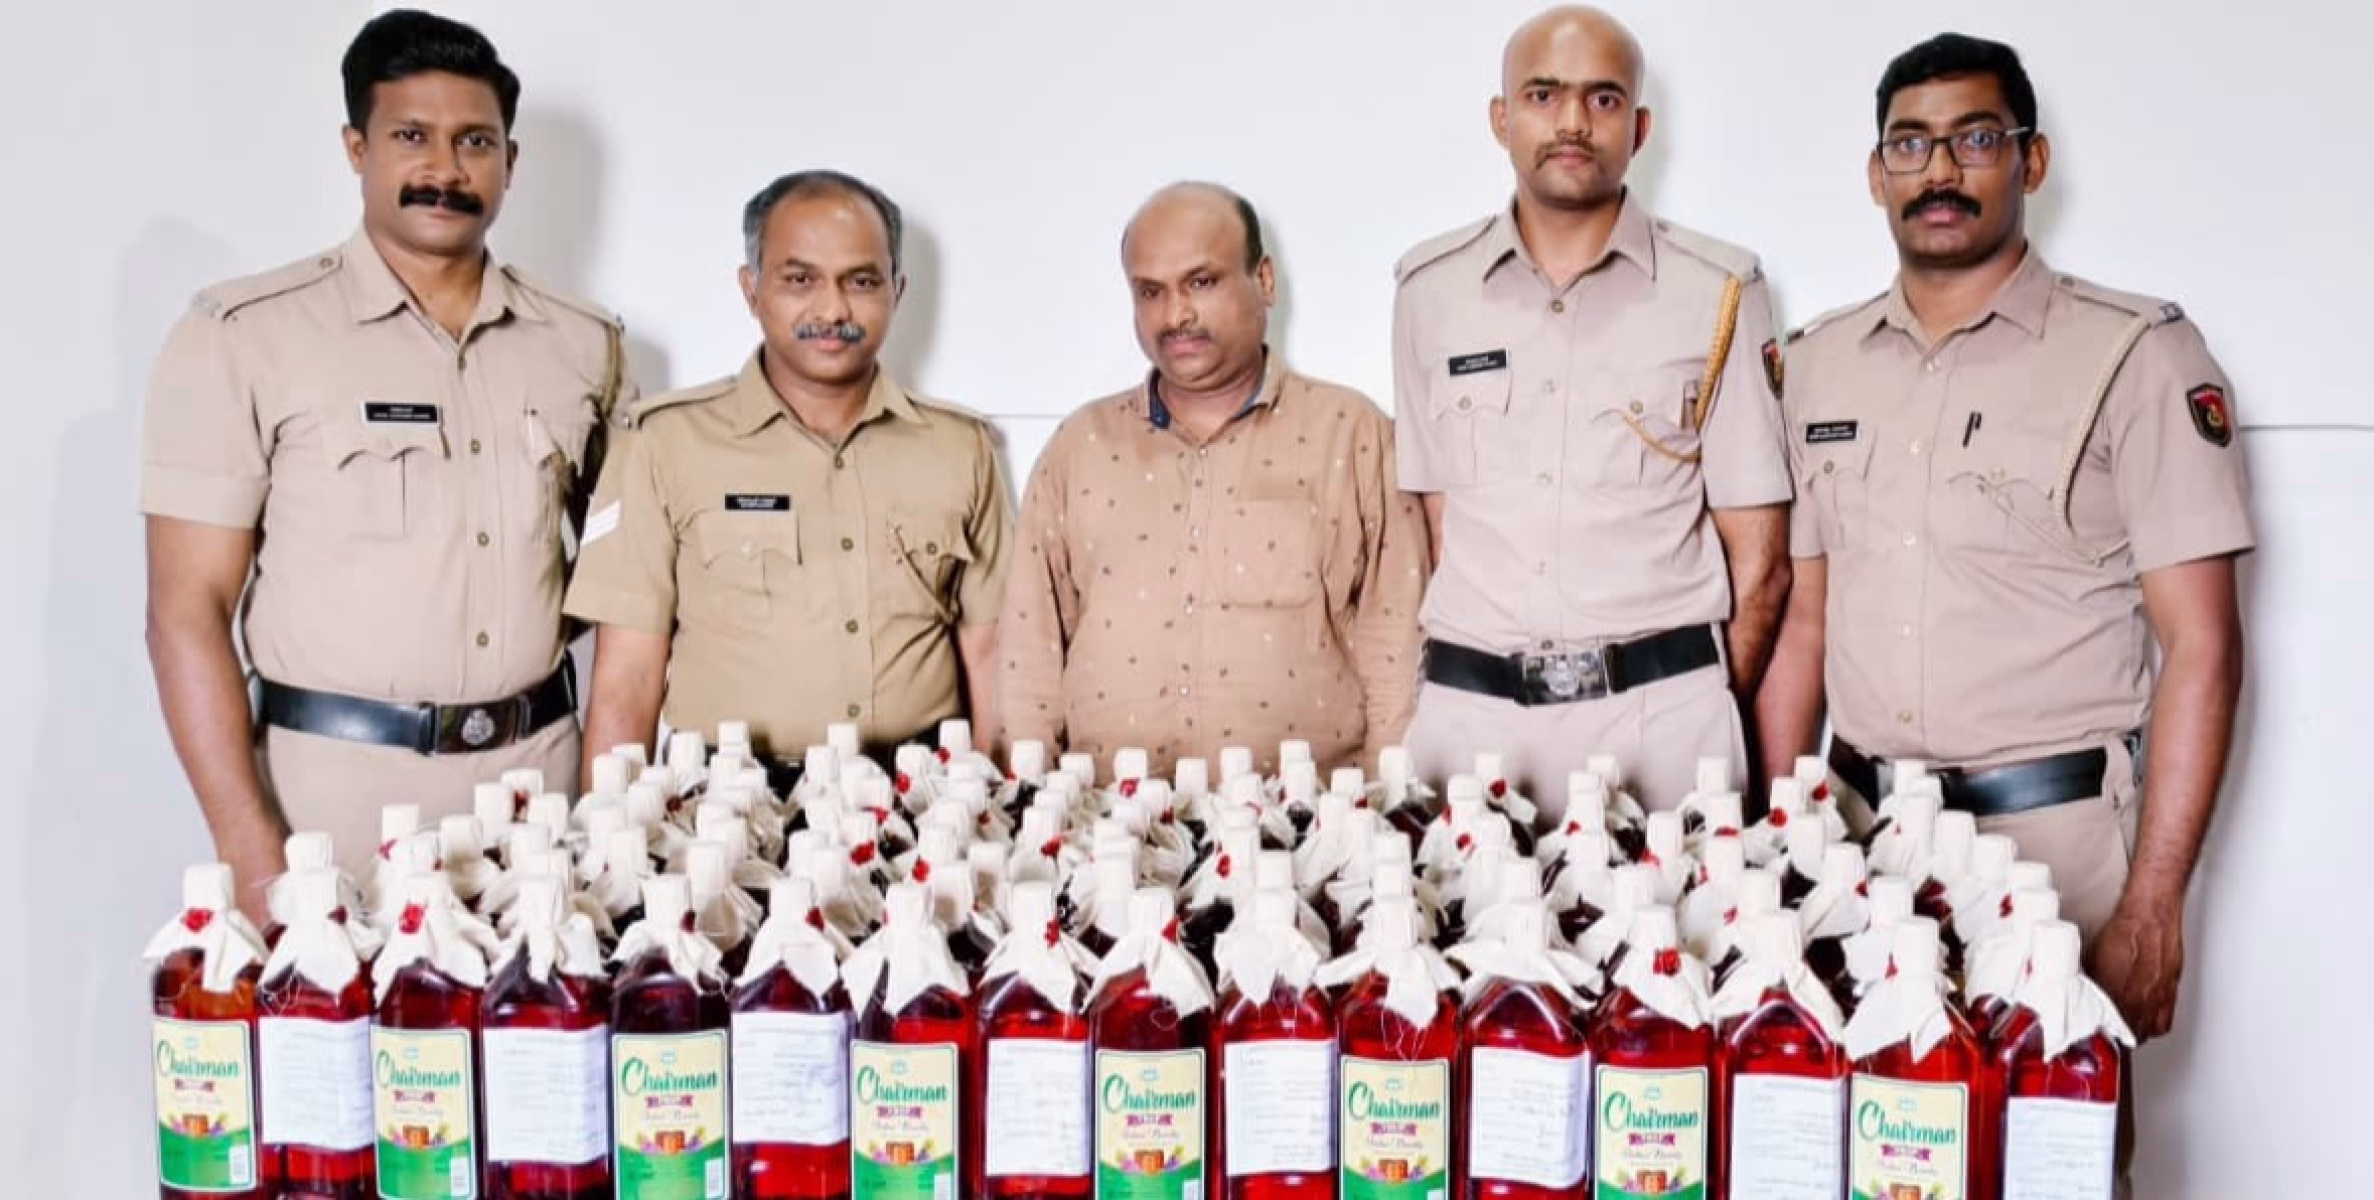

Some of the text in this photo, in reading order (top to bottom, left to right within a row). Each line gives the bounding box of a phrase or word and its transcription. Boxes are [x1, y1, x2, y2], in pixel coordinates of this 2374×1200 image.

[157, 1039, 239, 1077] Chairman
[376, 1050, 461, 1089] Chairman
[622, 1055, 718, 1095] Chairman
[857, 1065, 947, 1105] Chairman
[1103, 1073, 1196, 1113] Chairman
[1348, 1081, 1439, 1120] Chairman
[1604, 1090, 1698, 1132] Chairman
[1858, 1100, 1956, 1144] Chairman
